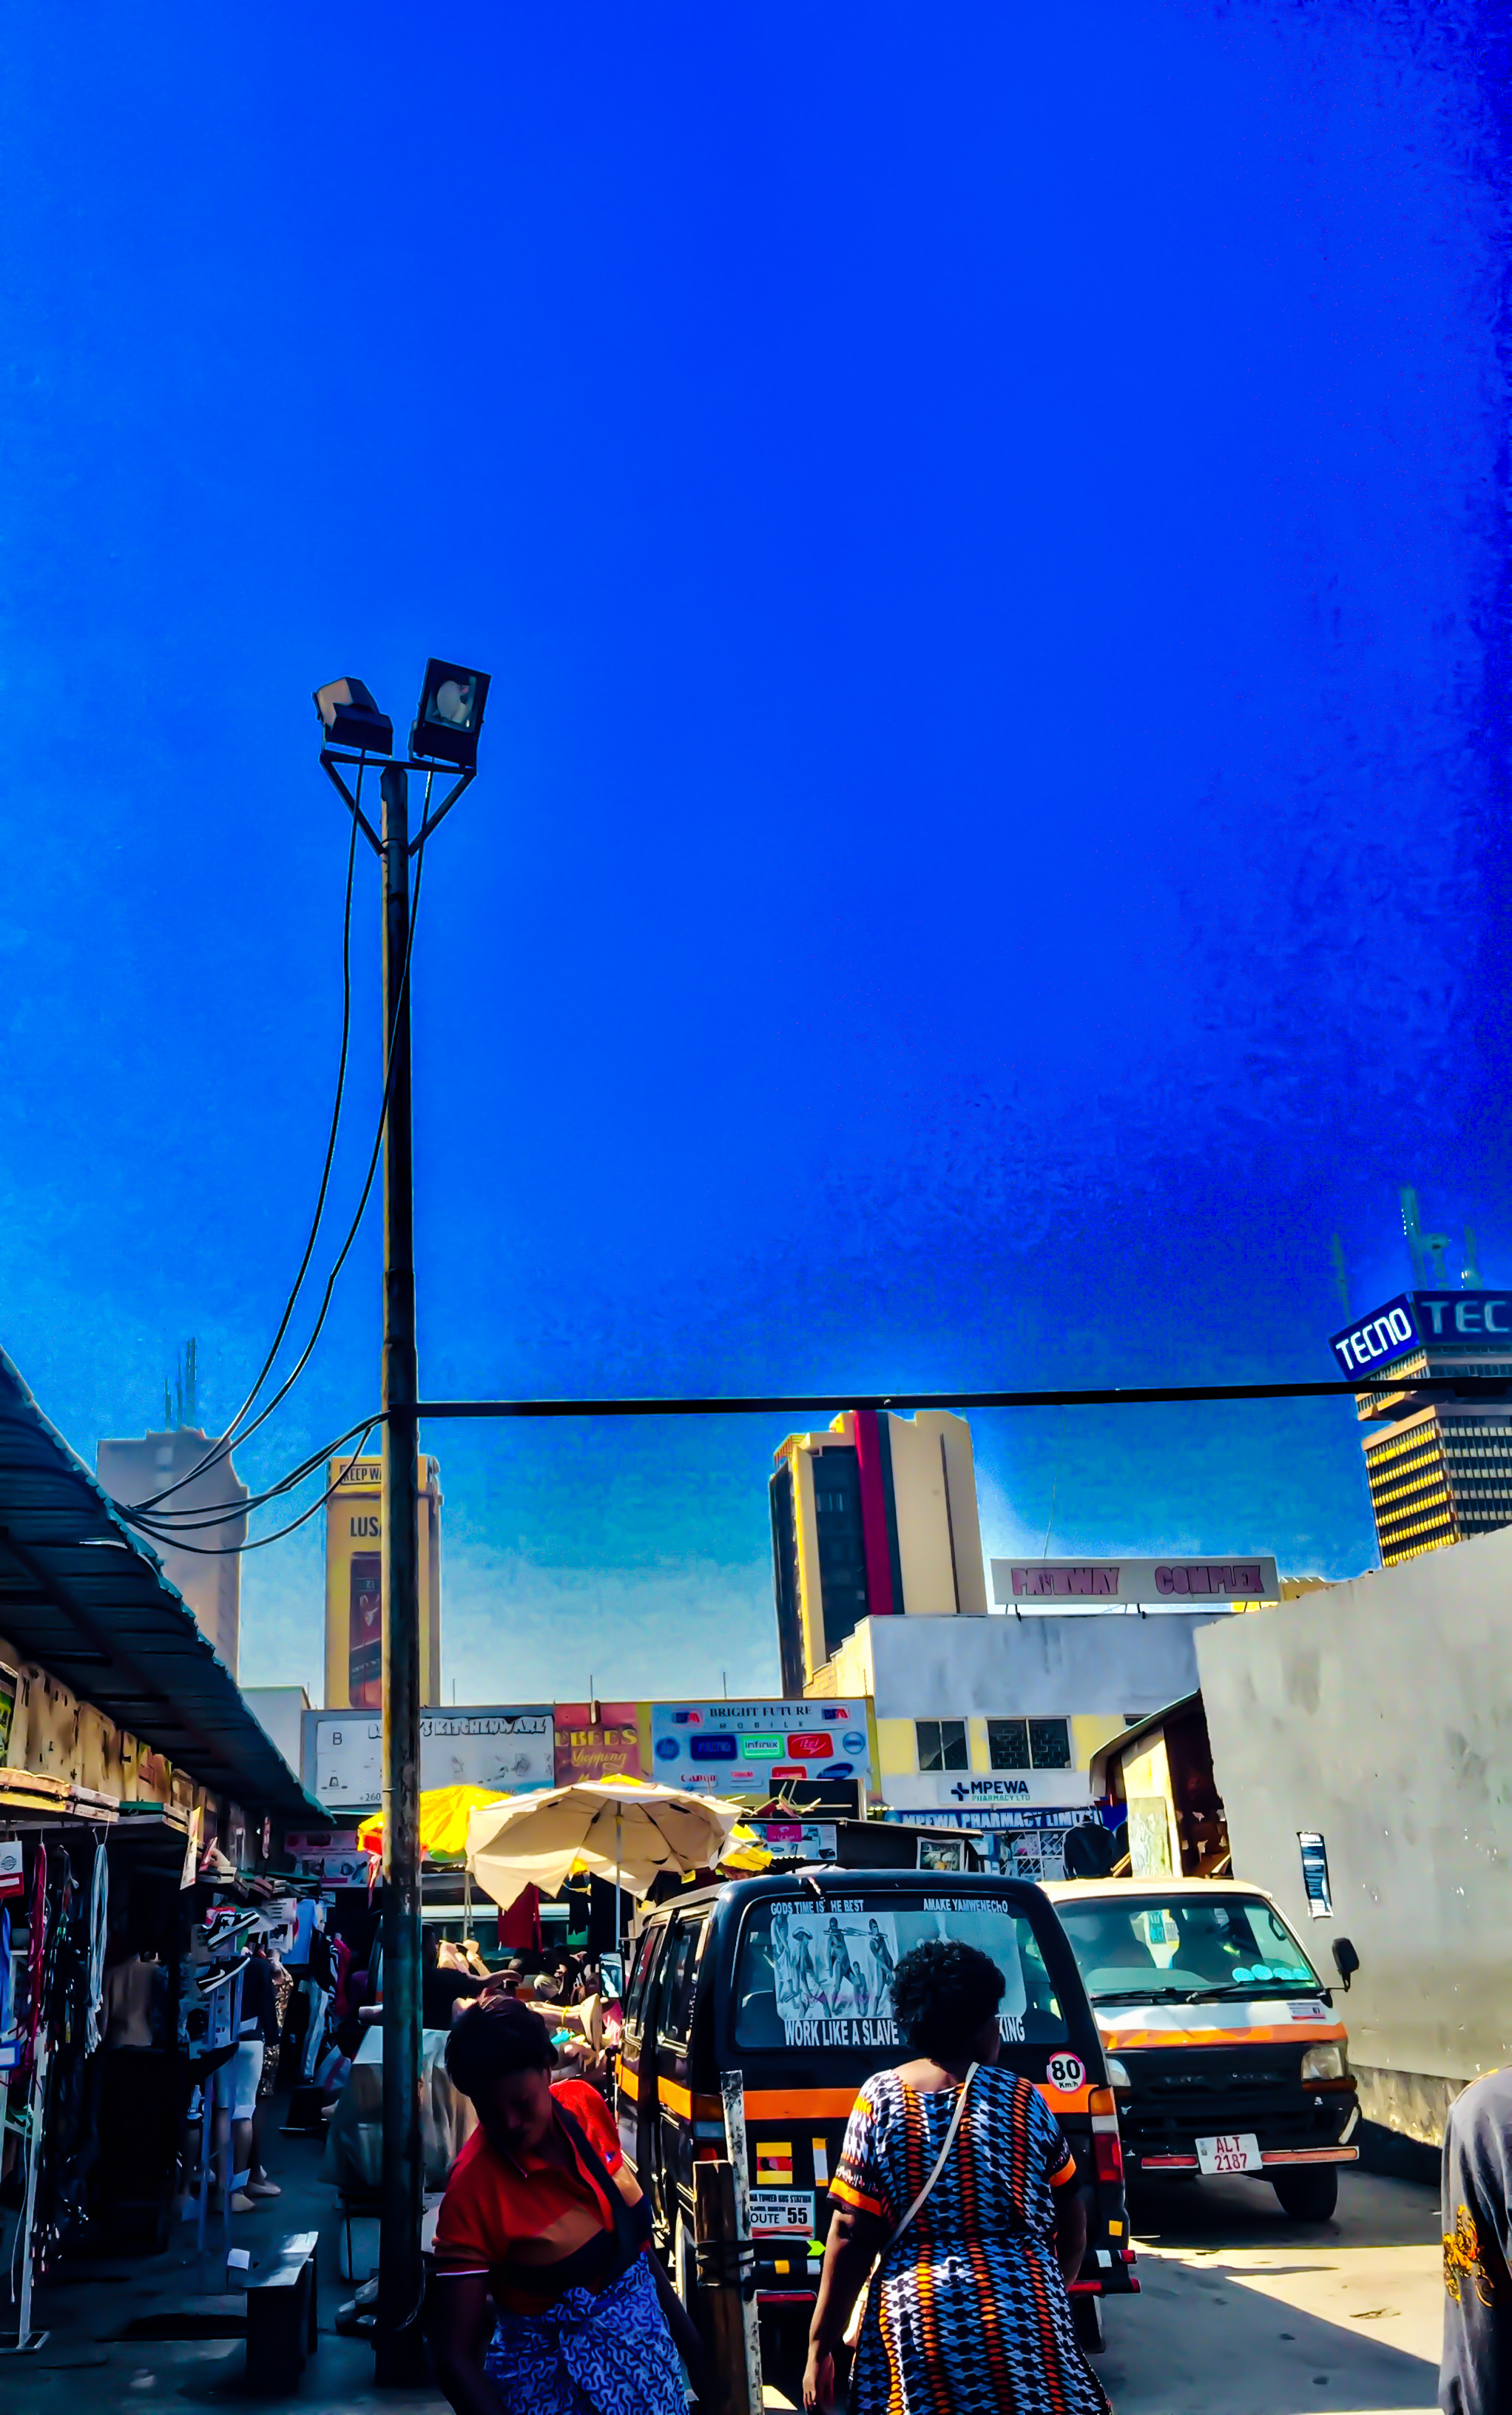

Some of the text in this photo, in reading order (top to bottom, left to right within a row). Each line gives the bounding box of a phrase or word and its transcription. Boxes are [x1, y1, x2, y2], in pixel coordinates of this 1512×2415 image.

[1421, 1301, 1512, 1334] TEC
[1335, 1307, 1412, 1370] TECNO
[351, 1517, 381, 1537] LUS
[1155, 1566, 1265, 1594] COMPLEX
[709, 1706, 812, 1717] BRIGHT FUTURE
[435, 1719, 546, 1736] KITCHENWARE
[971, 1781, 1029, 1794] MPEWA
[902, 1813, 960, 1828] MPEWA
[962, 1812, 1042, 1828] PHARMACY
[771, 1902, 793, 1915] GODS
[794, 1902, 814, 1914] TIME
[816, 1901, 825, 1913] IS
[843, 1899, 863, 1912] BEST
[923, 1899, 951, 1910] AMAKE
[784, 2019, 900, 2046] WORK LIKE A SLAVE
[1051, 2059, 1081, 2081] 80
[1216, 2137, 1240, 2153] ALT
[1215, 2153, 1247, 2170] 2187
[751, 2207, 808, 2224] OUTE 55
